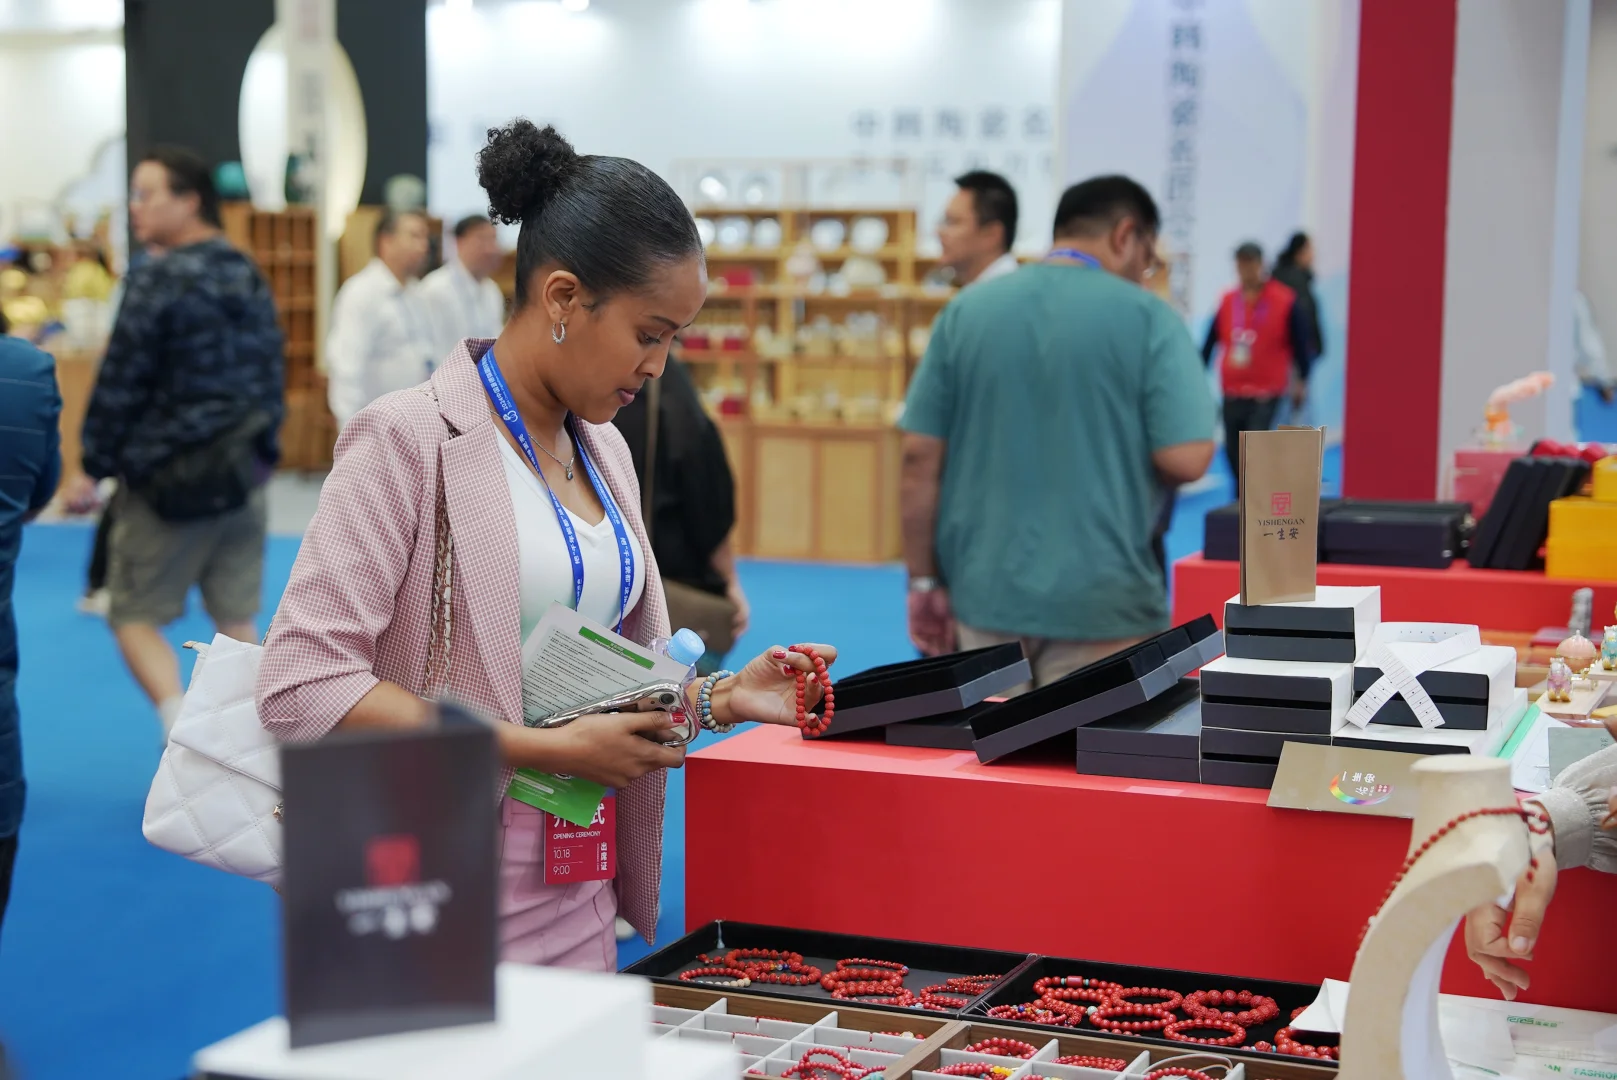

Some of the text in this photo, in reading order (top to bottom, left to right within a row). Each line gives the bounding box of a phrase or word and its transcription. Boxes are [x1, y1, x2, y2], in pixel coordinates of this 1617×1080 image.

[1258, 518, 1305, 526] YISHENGAN
[1263, 527, 1299, 541] 一生安
[553, 830, 601, 840] OPENING CEREMONY
[553, 848, 571, 859] 10.18
[553, 865, 570, 875] 9:00
